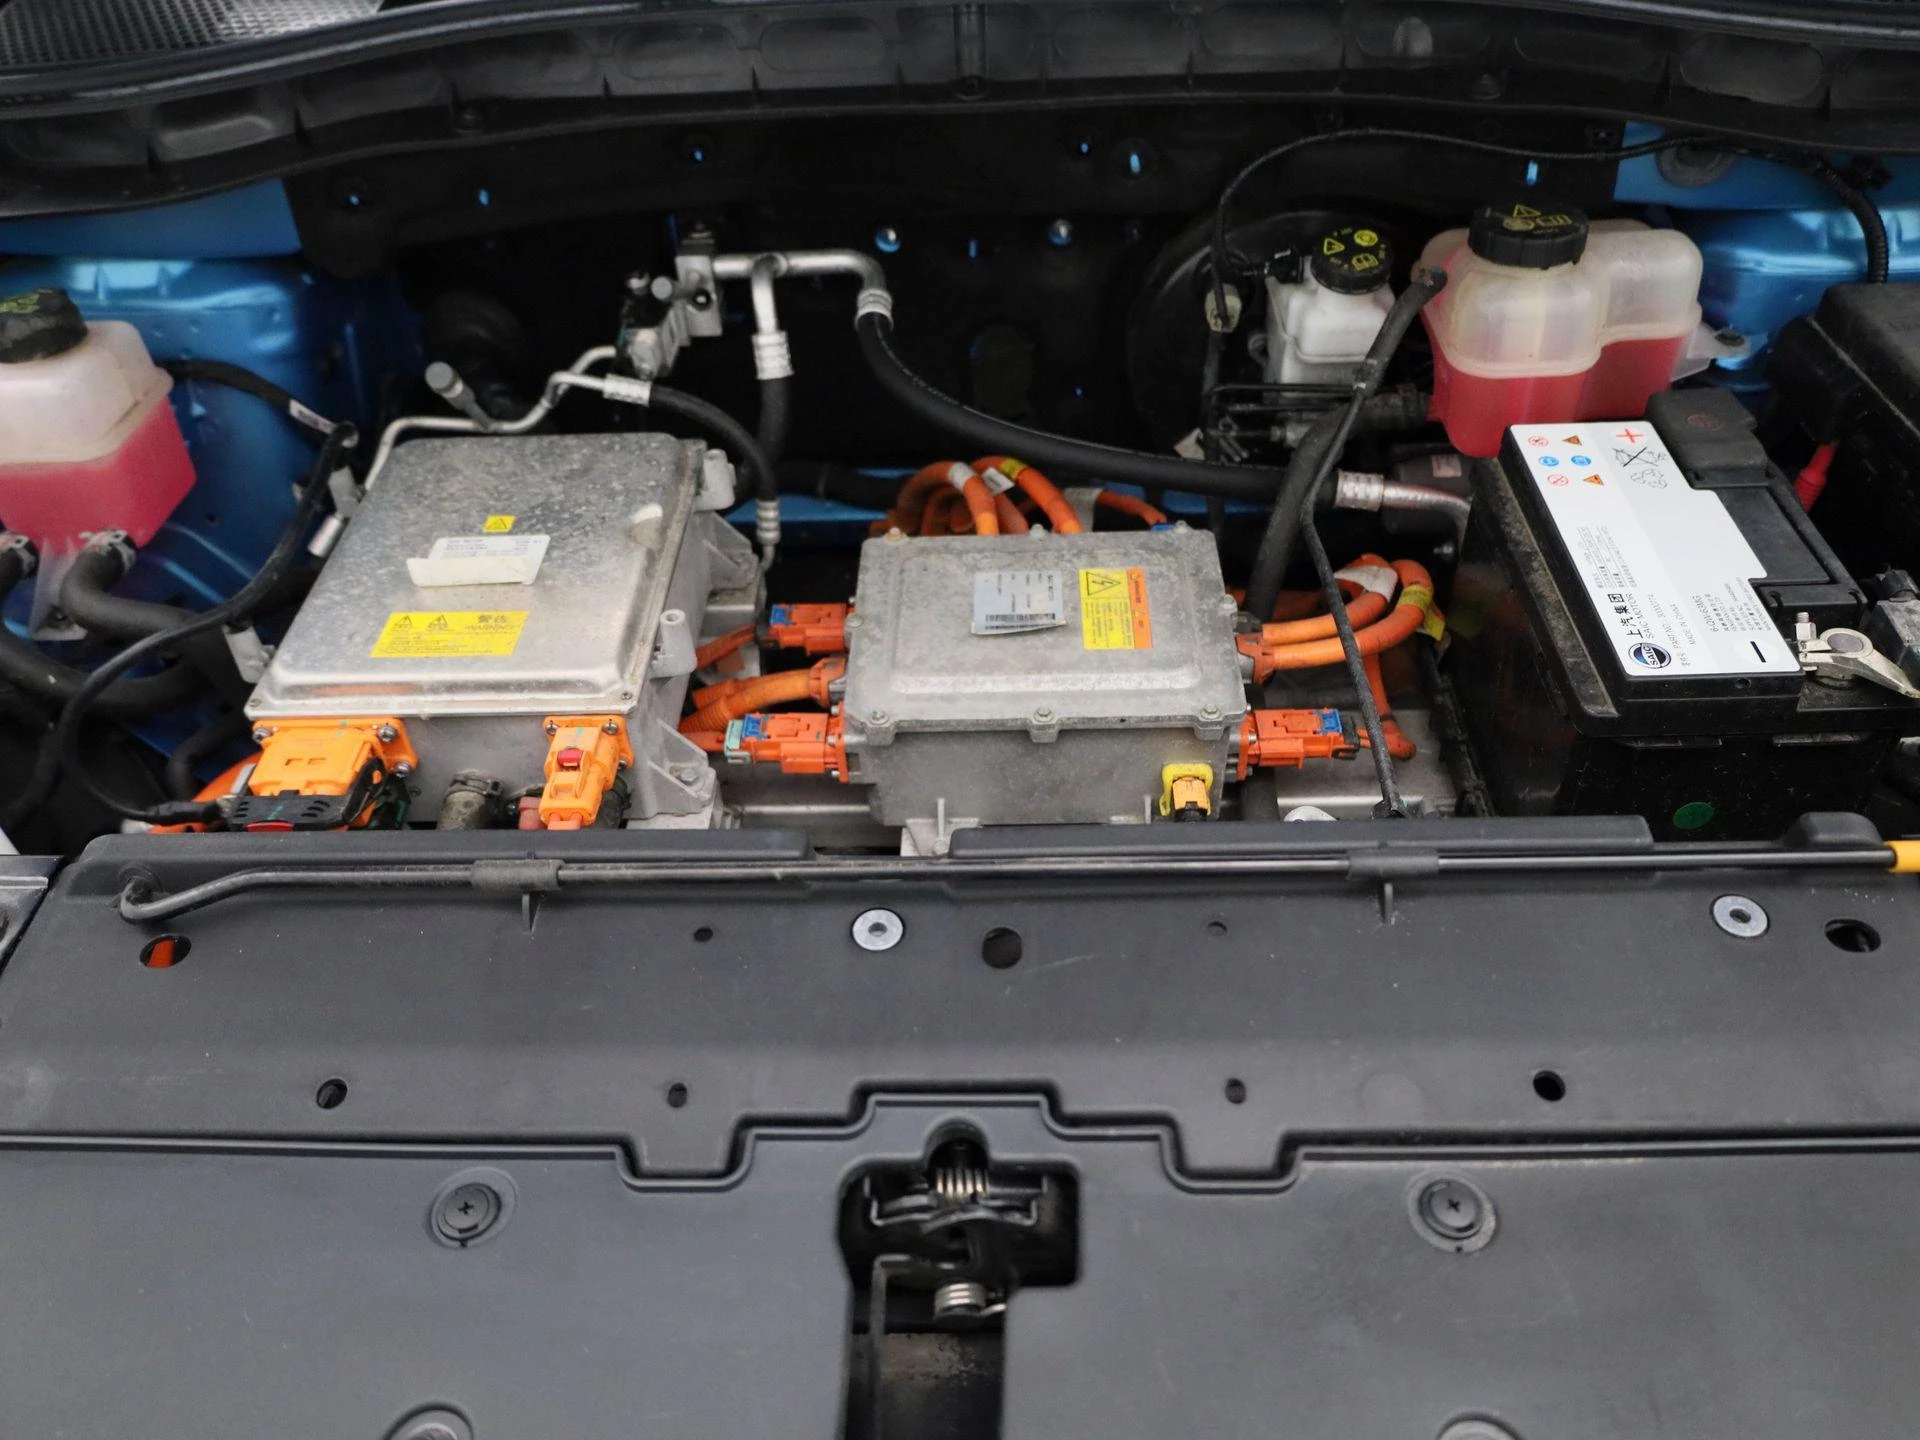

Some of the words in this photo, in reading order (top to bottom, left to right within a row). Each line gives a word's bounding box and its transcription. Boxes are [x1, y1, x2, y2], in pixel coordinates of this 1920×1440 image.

[1607, 593, 1644, 639] 上汽集团
[1642, 645, 1659, 666] SAIC
